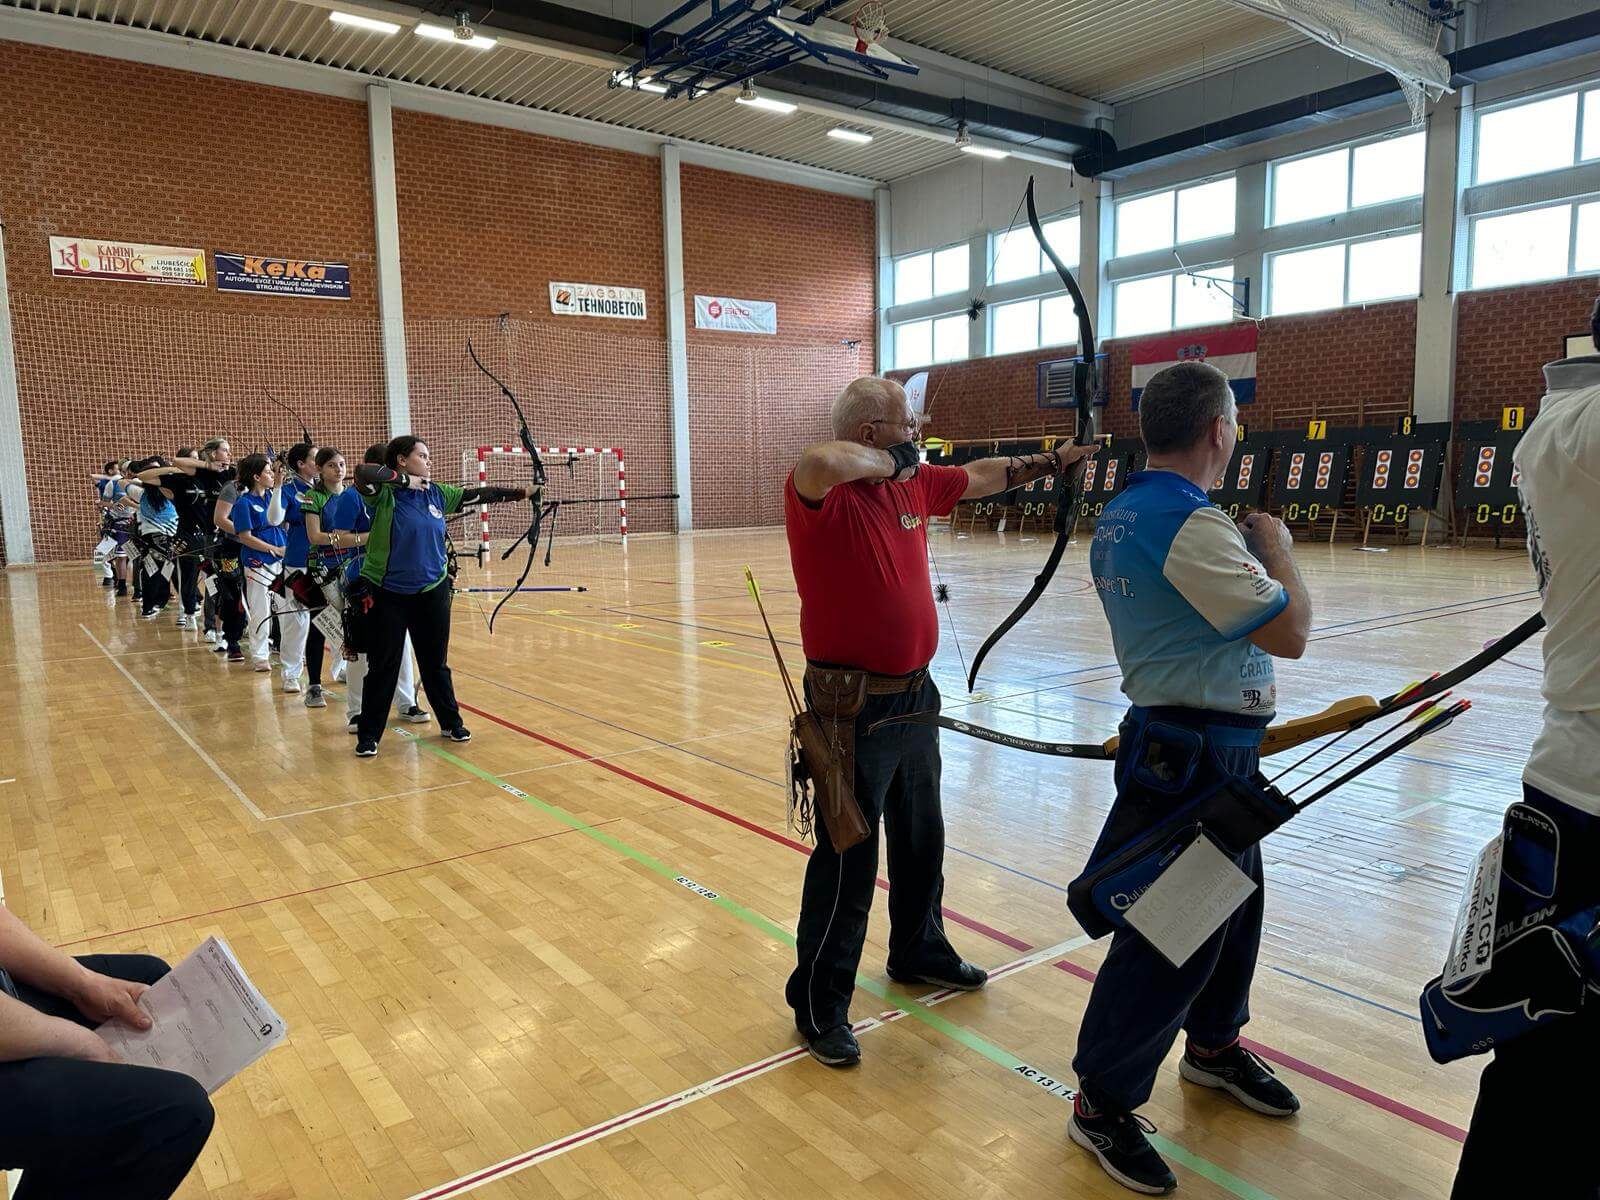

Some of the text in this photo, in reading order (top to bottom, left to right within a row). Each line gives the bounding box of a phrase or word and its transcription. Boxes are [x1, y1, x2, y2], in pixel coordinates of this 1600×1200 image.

[97, 245, 134, 258] KAMINI
[99, 254, 145, 273] LIPIĆ
[244, 256, 326, 279] KeKa
[256, 284, 293, 292] STROJEVIMA
[578, 297, 644, 317] TEHNOBETON
[1402, 416, 1411, 435] 8
[1509, 408, 1517, 428] 9
[1237, 424, 1244, 441] 6
[1314, 422, 1321, 439] 7
[994, 440, 999, 453] 2
[975, 502, 994, 515] 0-0
[1024, 502, 1044, 515] 0-0
[1081, 502, 1103, 517] 0-0
[1288, 503, 1320, 520] 0-0
[1372, 504, 1408, 522] 0-0
[1476, 504, 1517, 524] 0-0
[1014, 1065, 1037, 1077] AC
[1035, 1075, 1055, 1088] 13
[1061, 1089, 1077, 1102] 13
